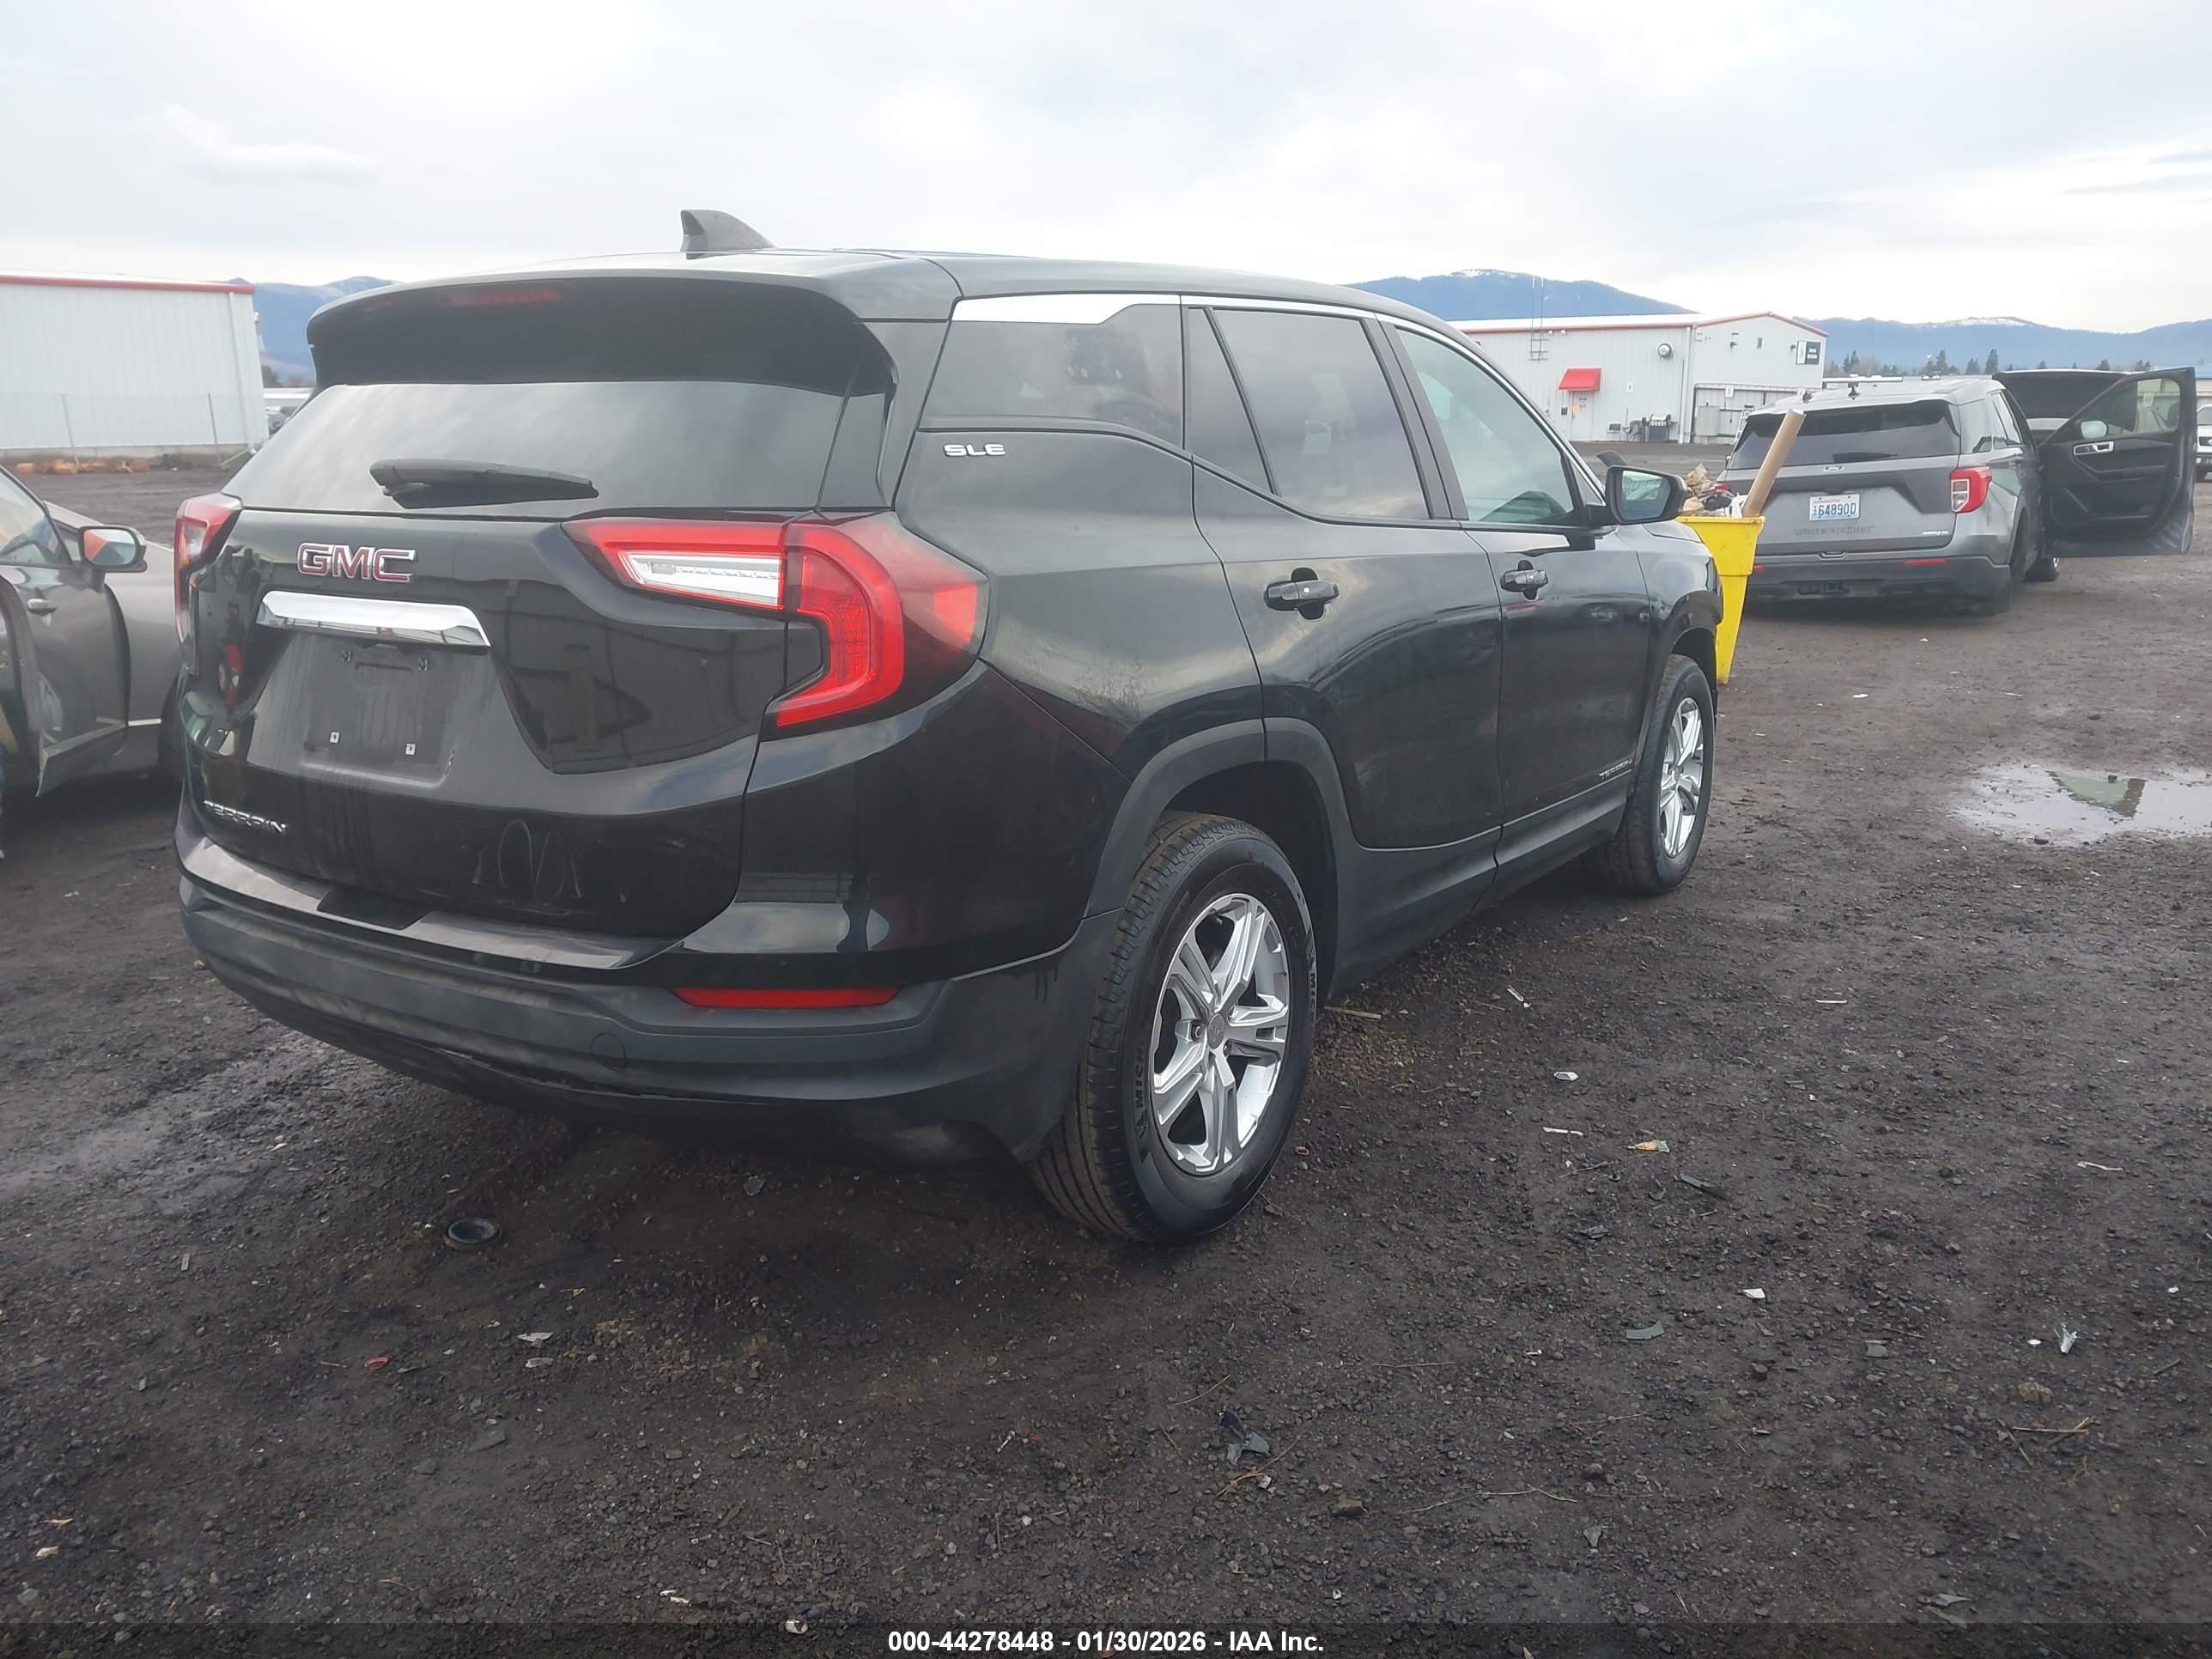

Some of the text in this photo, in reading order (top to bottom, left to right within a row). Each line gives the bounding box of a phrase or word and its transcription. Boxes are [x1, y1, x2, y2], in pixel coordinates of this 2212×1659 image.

[943, 443, 1006, 457] SLE
[1818, 502, 1856, 516] 64890D
[296, 542, 416, 583] GMC
[203, 799, 287, 833] TERRAIN
